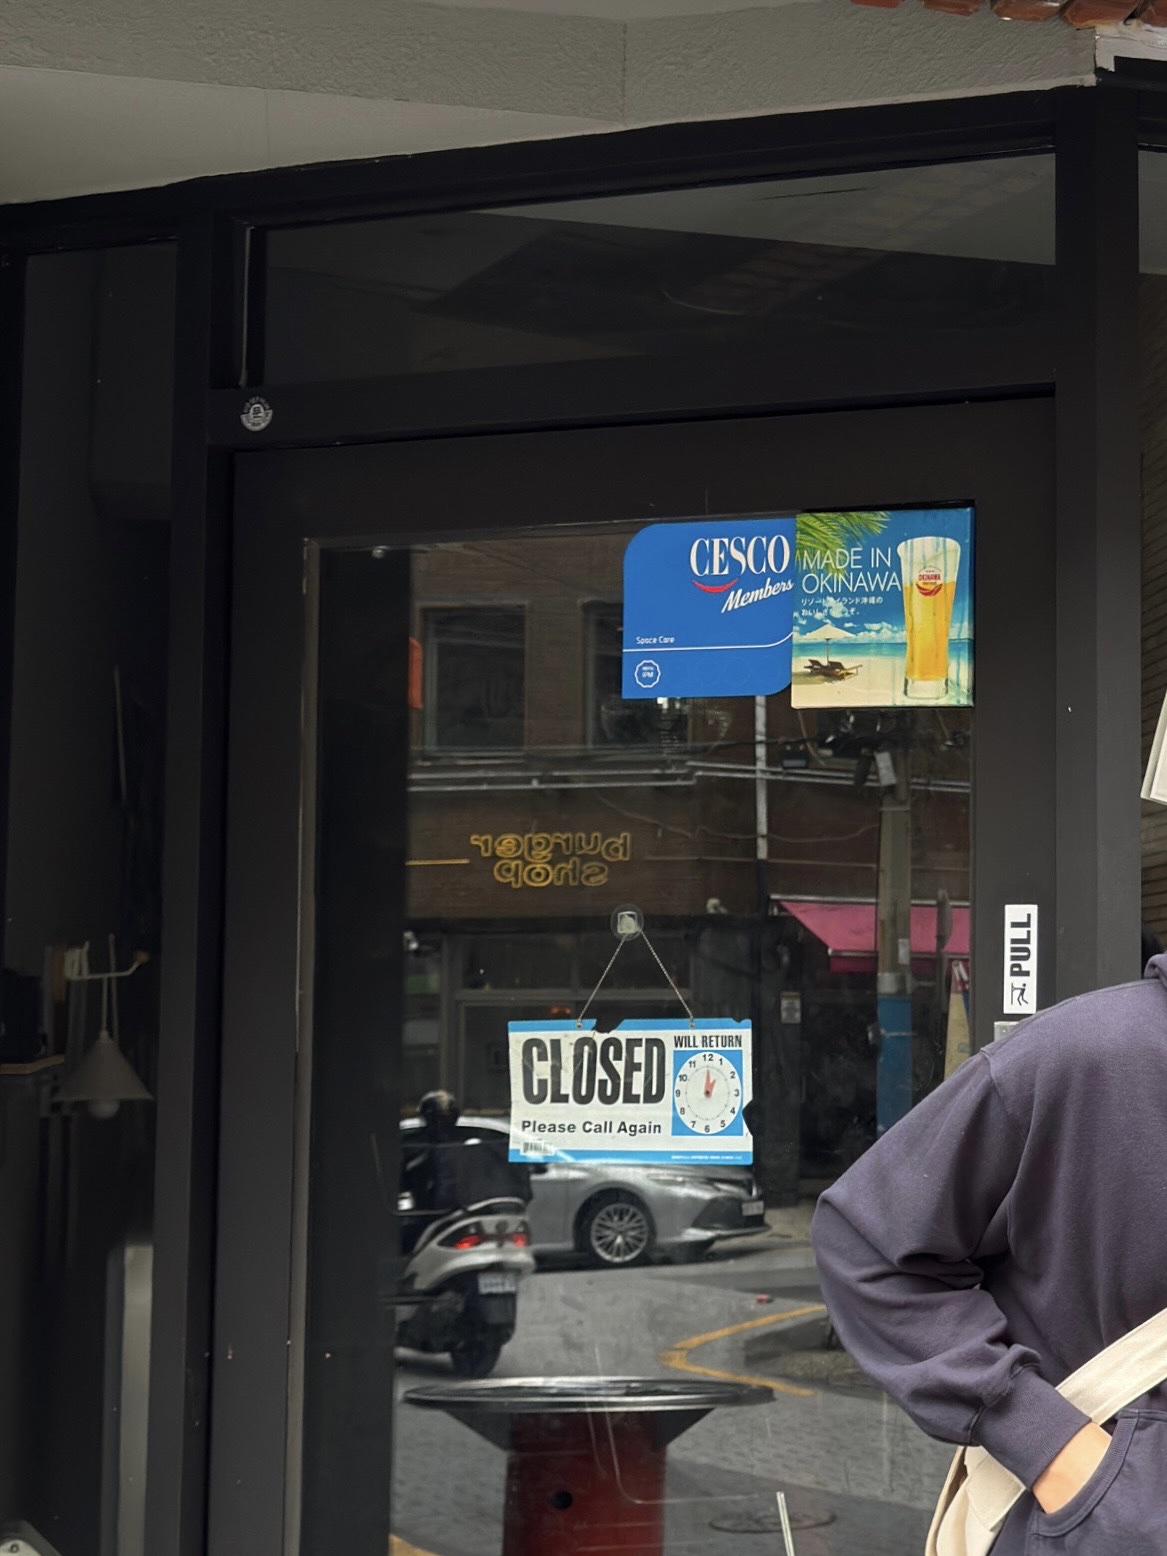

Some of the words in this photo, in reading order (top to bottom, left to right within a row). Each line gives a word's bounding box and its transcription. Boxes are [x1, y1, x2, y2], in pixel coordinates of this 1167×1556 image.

[690, 534, 790, 577] CESCO
[802, 548, 862, 571] MADE
[870, 546, 892, 569] IN
[801, 572, 902, 595] OKINAWA
[721, 578, 795, 614] Members
[636, 636, 658, 645] Space
[658, 636, 675, 644] Care
[1009, 913, 1032, 977] PULL
[673, 1035, 698, 1048] WILL
[701, 1035, 743, 1048] RETURN
[688, 1060, 697, 1068] 11
[702, 1053, 714, 1061] 12
[521, 1037, 666, 1106] CLOSED
[678, 1074, 688, 1082] 10
[521, 1120, 577, 1134] Please
[581, 1120, 613, 1134] Call
[617, 1121, 662, 1137] Again
